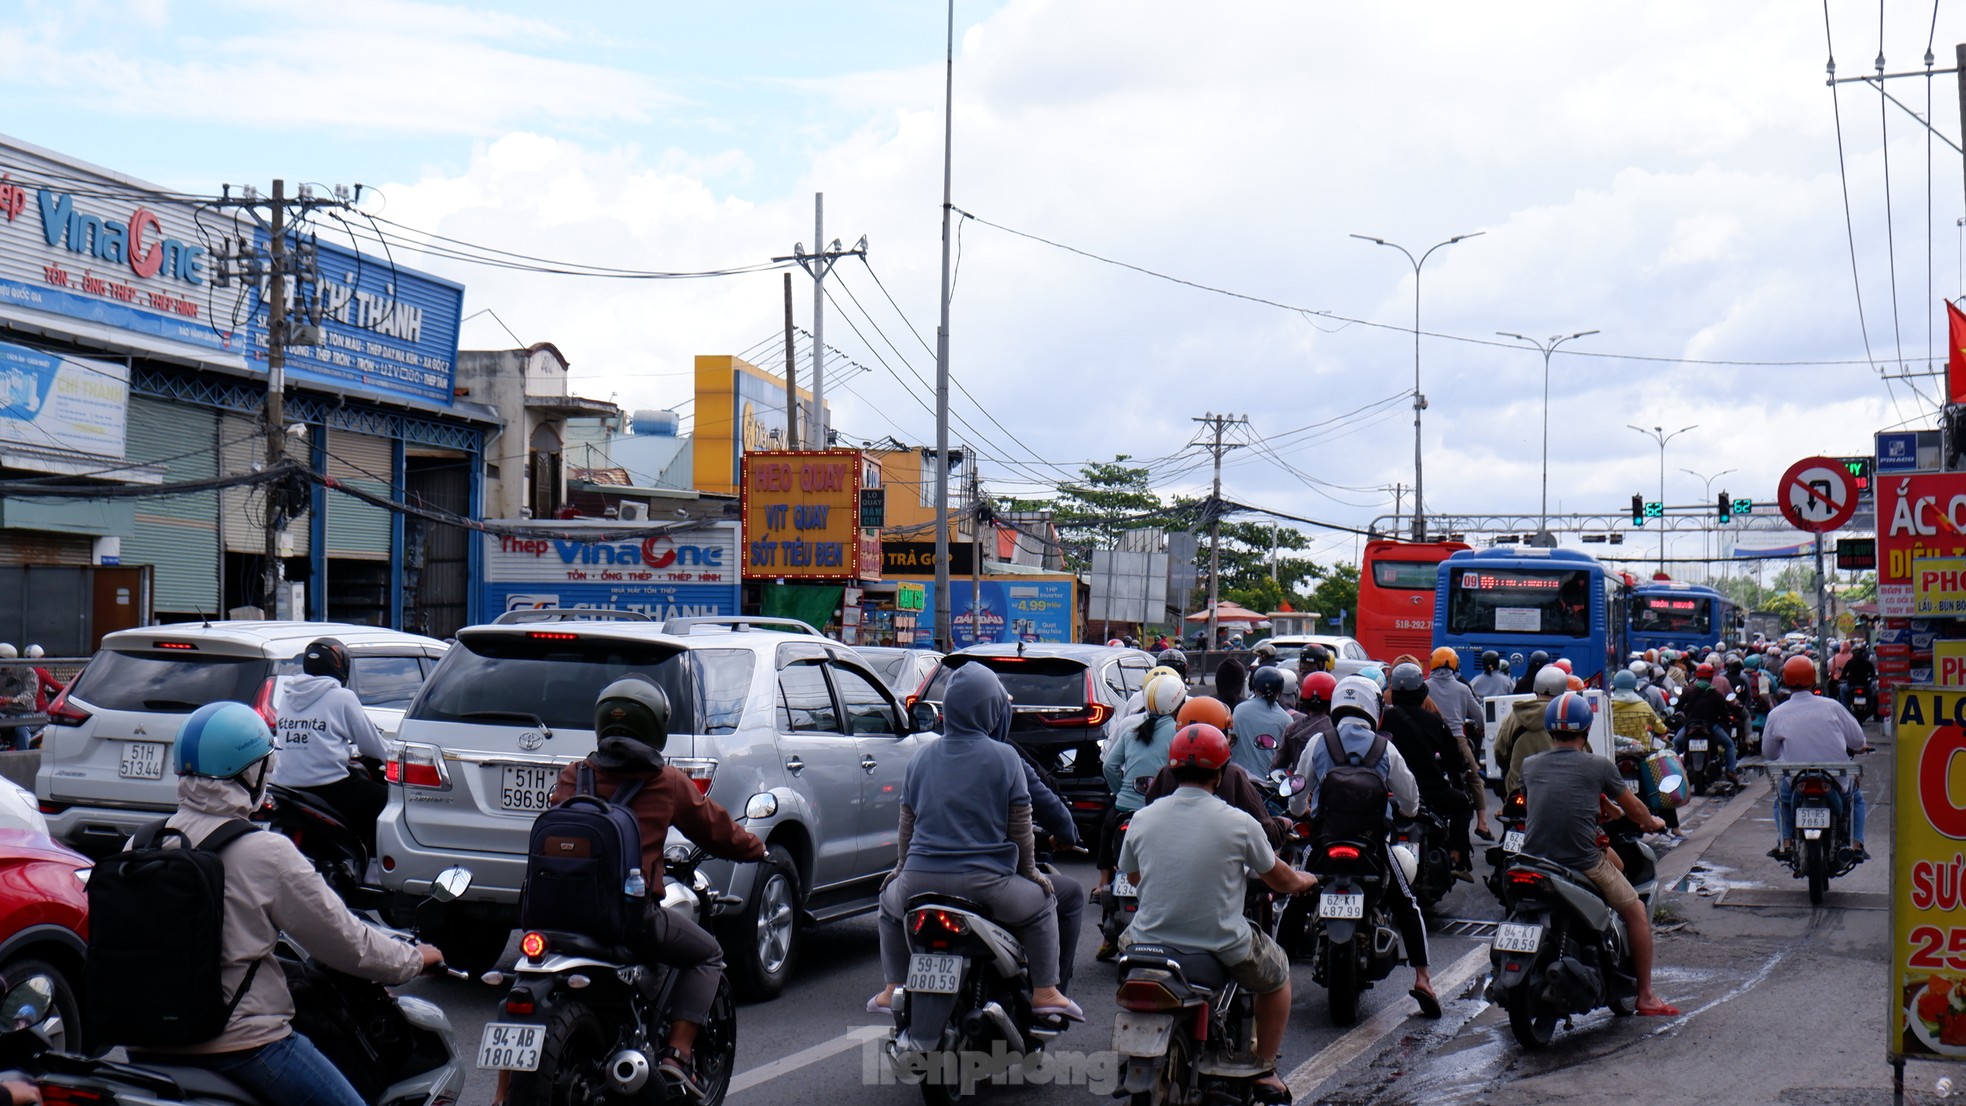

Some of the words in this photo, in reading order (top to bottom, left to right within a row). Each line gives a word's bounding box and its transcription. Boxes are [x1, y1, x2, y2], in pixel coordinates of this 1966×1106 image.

[43, 261, 68, 286] TÔN
[83, 269, 107, 296] ỐNG
[110, 279, 138, 302] THÉP
[147, 289, 175, 313] THÉP
[174, 294, 199, 318] HÌNH
[354, 282, 423, 343] THÀNH
[754, 463, 793, 492] HEO
[800, 463, 847, 494] QUAY
[1645, 502, 1662, 517] 62
[1733, 499, 1751, 513] 62
[1889, 476, 1937, 537] ẮC
[764, 504, 788, 533] VỊT
[793, 504, 830, 531] QUAY
[750, 532, 778, 567] SỐT
[815, 541, 844, 567] ĐEN
[888, 549, 917, 565] TRẢ
[567, 569, 587, 581] TÔN
[601, 568, 622, 581] ỐNG
[628, 569, 653, 582] THÉP
[667, 570, 692, 582] THÉP
[698, 570, 721, 582] HÌNH
[1464, 575, 1477, 587] 09
[611, 586, 626, 594] NHÀ
[627, 586, 642, 594] MÁY
[644, 585, 658, 594] TÔN
[660, 586, 677, 594] THÉP
[1395, 619, 1434, 629] 51B-292.7
[1899, 695, 1925, 725] A
[278, 717, 327, 732] Eternita
[131, 745, 155, 760] 51H
[120, 760, 160, 776] 513.44
[516, 769, 545, 789] 51H
[1801, 810, 1825, 818] 51-R5
[1801, 818, 1826, 826] 7063
[1912, 855, 1966, 909] SƯ
[1326, 894, 1356, 905] 62-K1
[1322, 906, 1361, 917] 487.99
[1504, 924, 1535, 939] 84-K1
[1135, 946, 1165, 954] HONDA
[1497, 938, 1535, 951] 478.59
[917, 958, 954, 973] 59-D2
[910, 974, 956, 990] 080.59
[492, 1028, 535, 1047] 94-AB
[484, 1047, 537, 1068] 180.43
